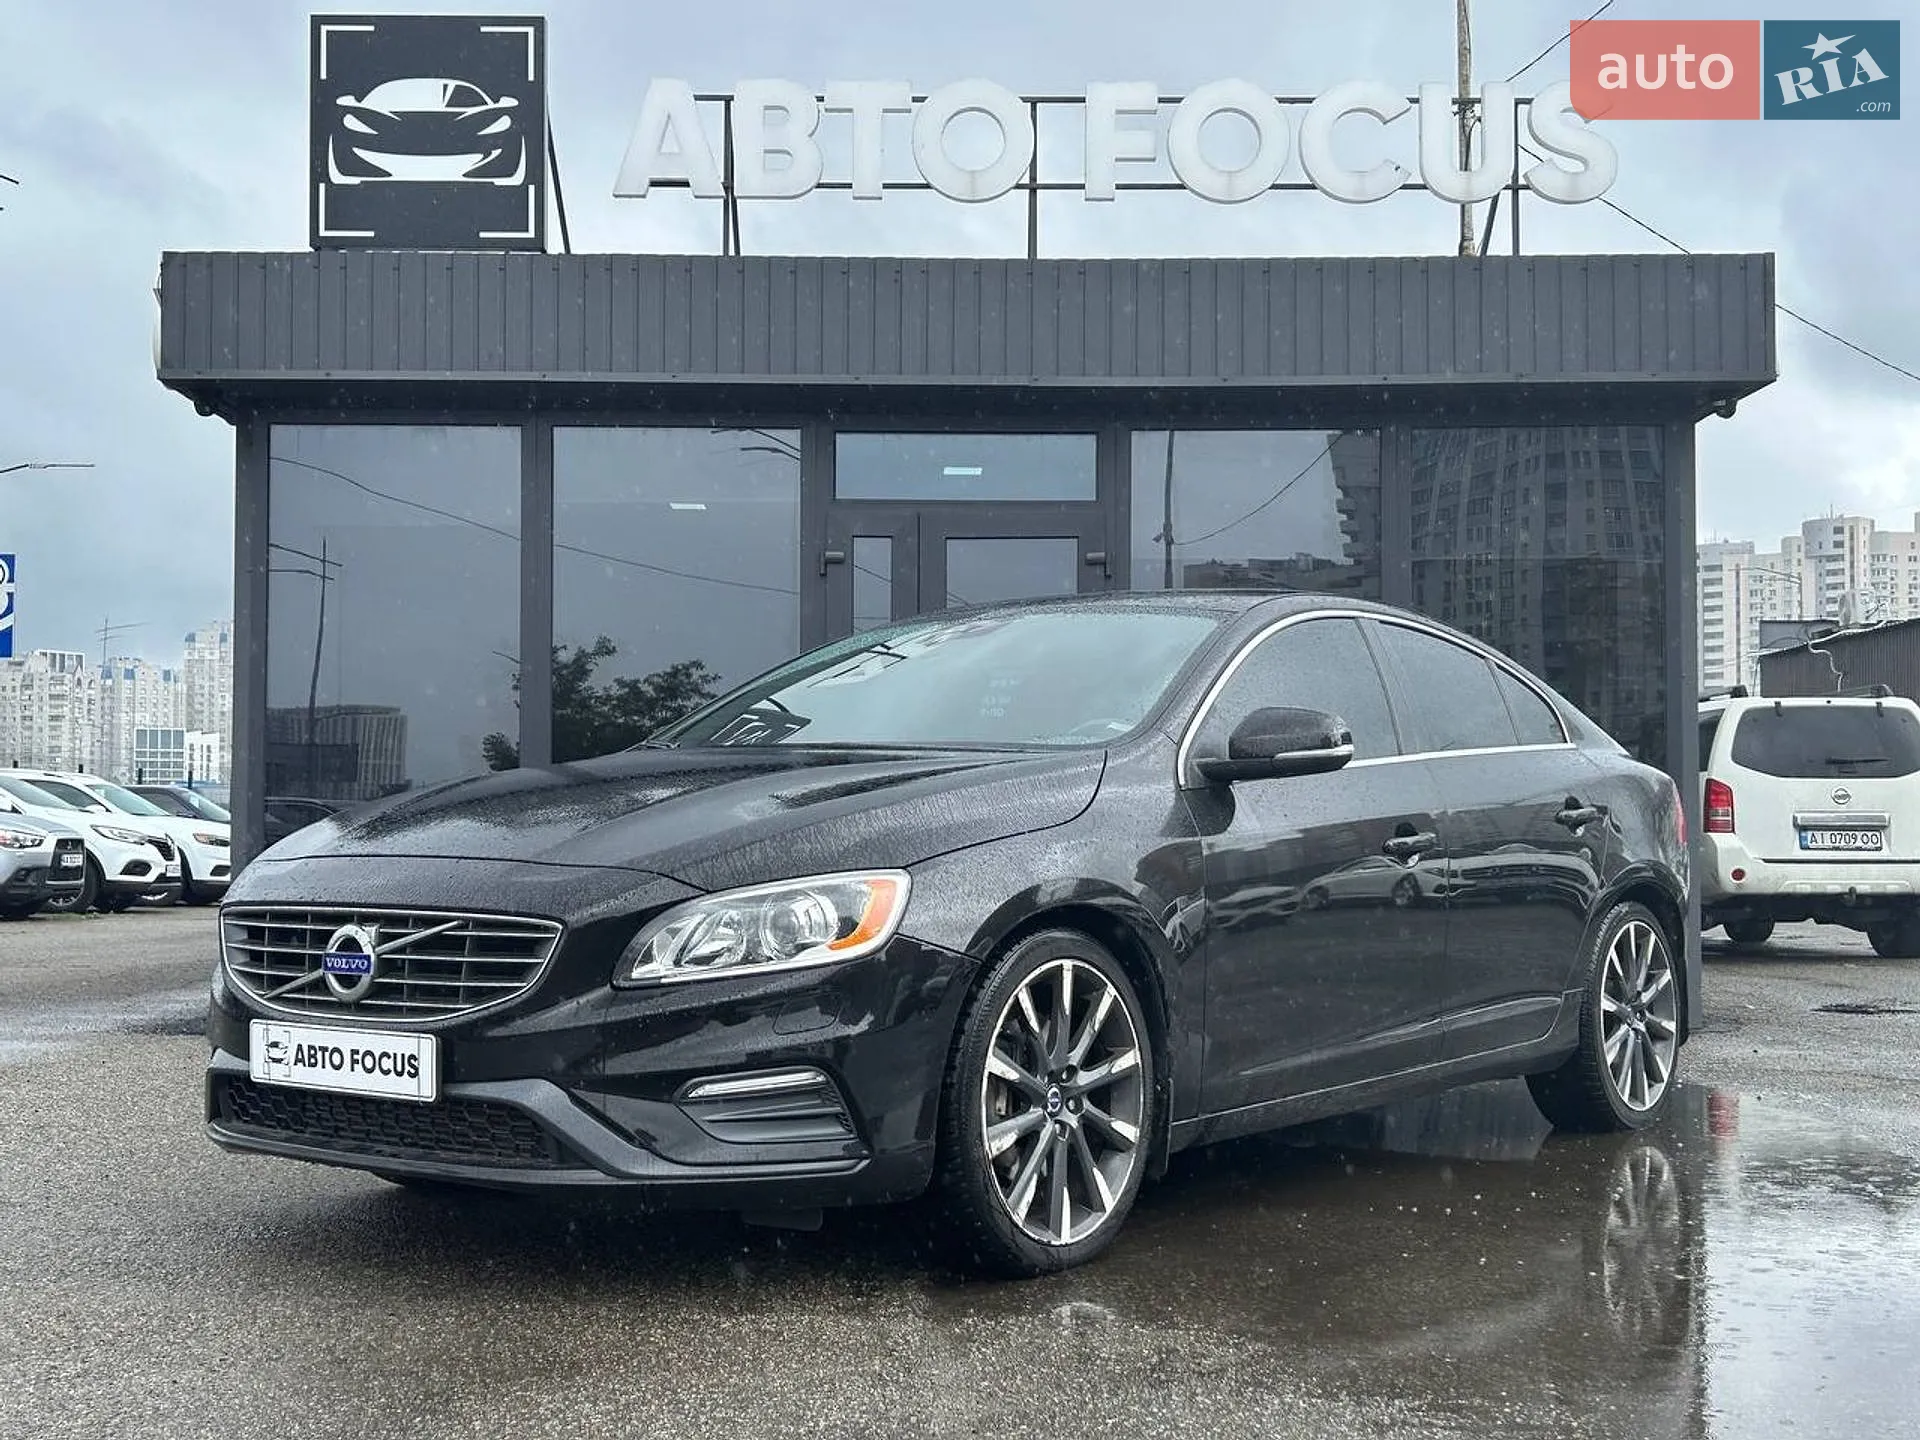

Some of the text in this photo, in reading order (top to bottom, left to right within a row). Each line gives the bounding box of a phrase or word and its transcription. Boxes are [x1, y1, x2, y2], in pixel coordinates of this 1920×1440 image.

[612, 77, 1620, 206] АВТО FOCUS
[1829, 832, 1858, 844] 0709
[325, 956, 369, 971] VOLVO
[293, 1043, 420, 1079] АВТО FOCUS
